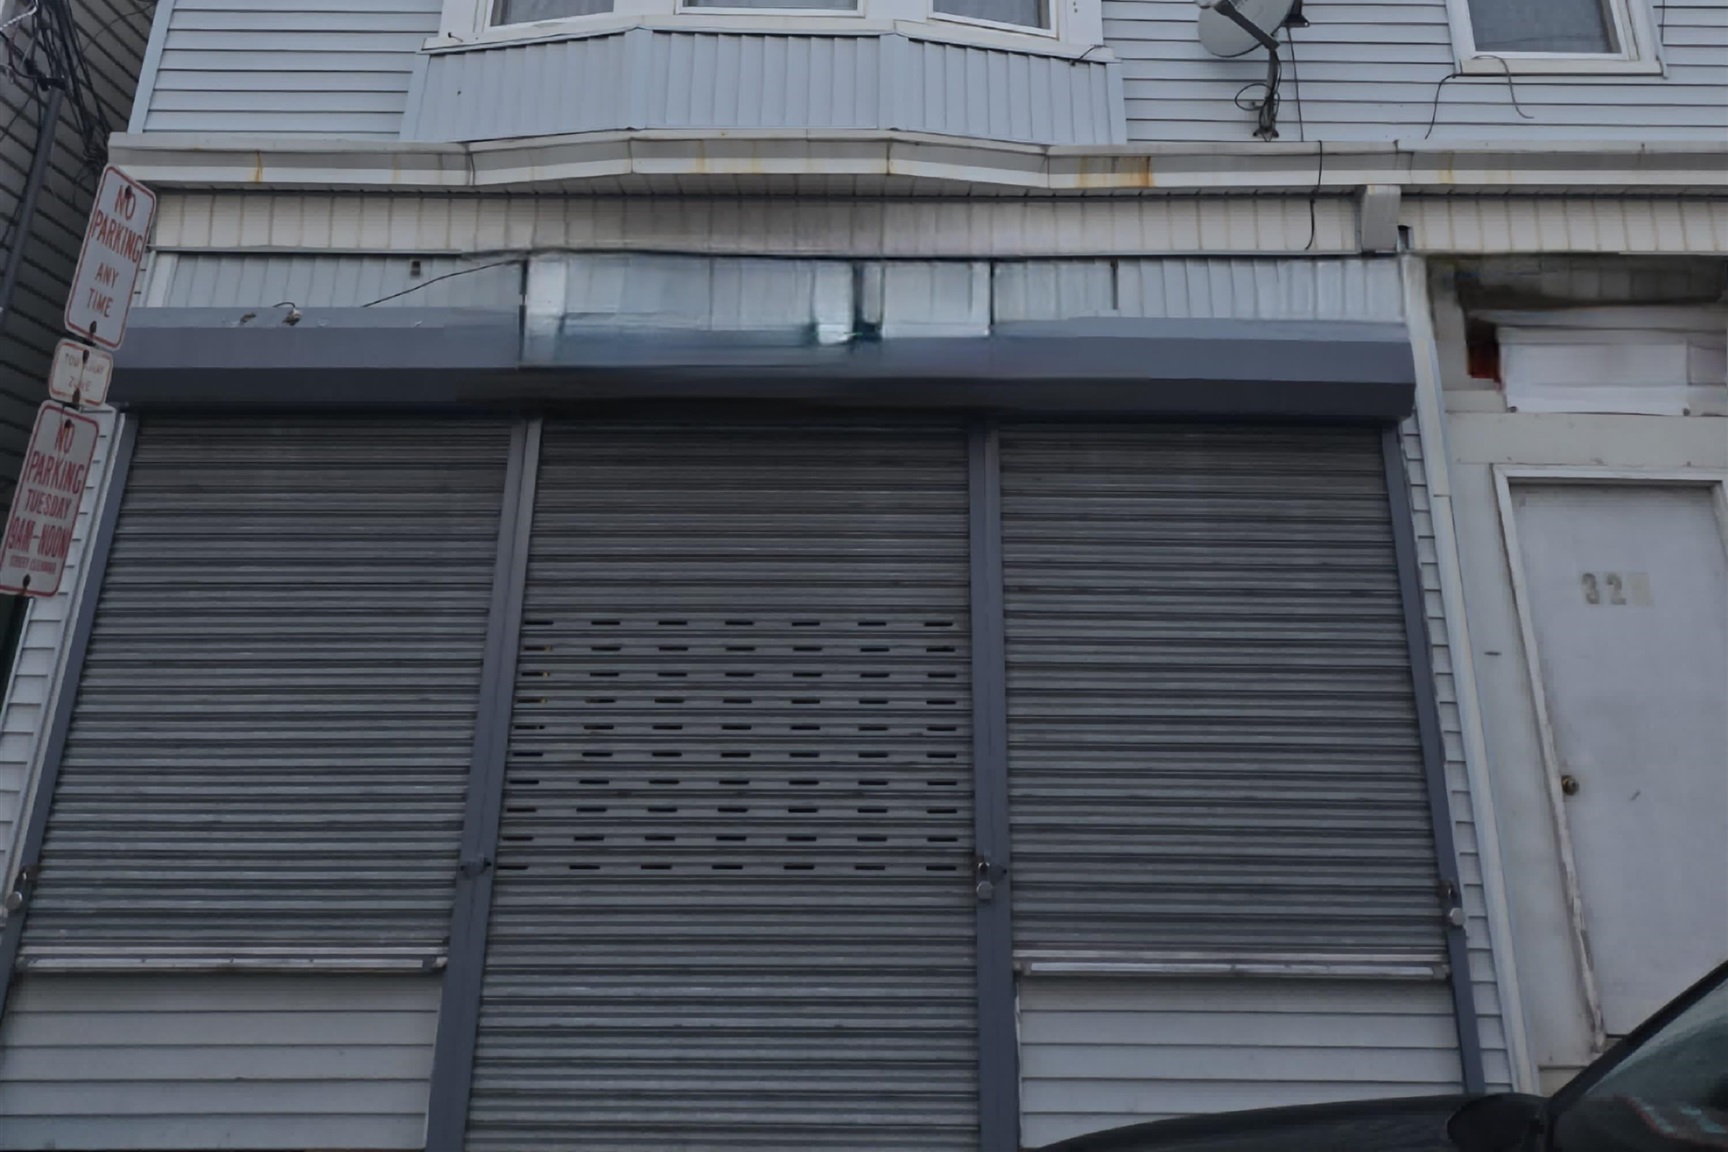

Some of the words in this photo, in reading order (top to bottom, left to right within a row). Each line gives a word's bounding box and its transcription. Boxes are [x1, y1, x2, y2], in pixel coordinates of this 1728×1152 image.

[115, 185, 136, 220] NO
[91, 209, 143, 263] PARKING
[95, 263, 119, 288] ANY
[87, 288, 113, 318] TIME
[55, 423, 75, 454] NO
[27, 451, 85, 494] PARKING
[25, 488, 72, 520] TUESDAY
